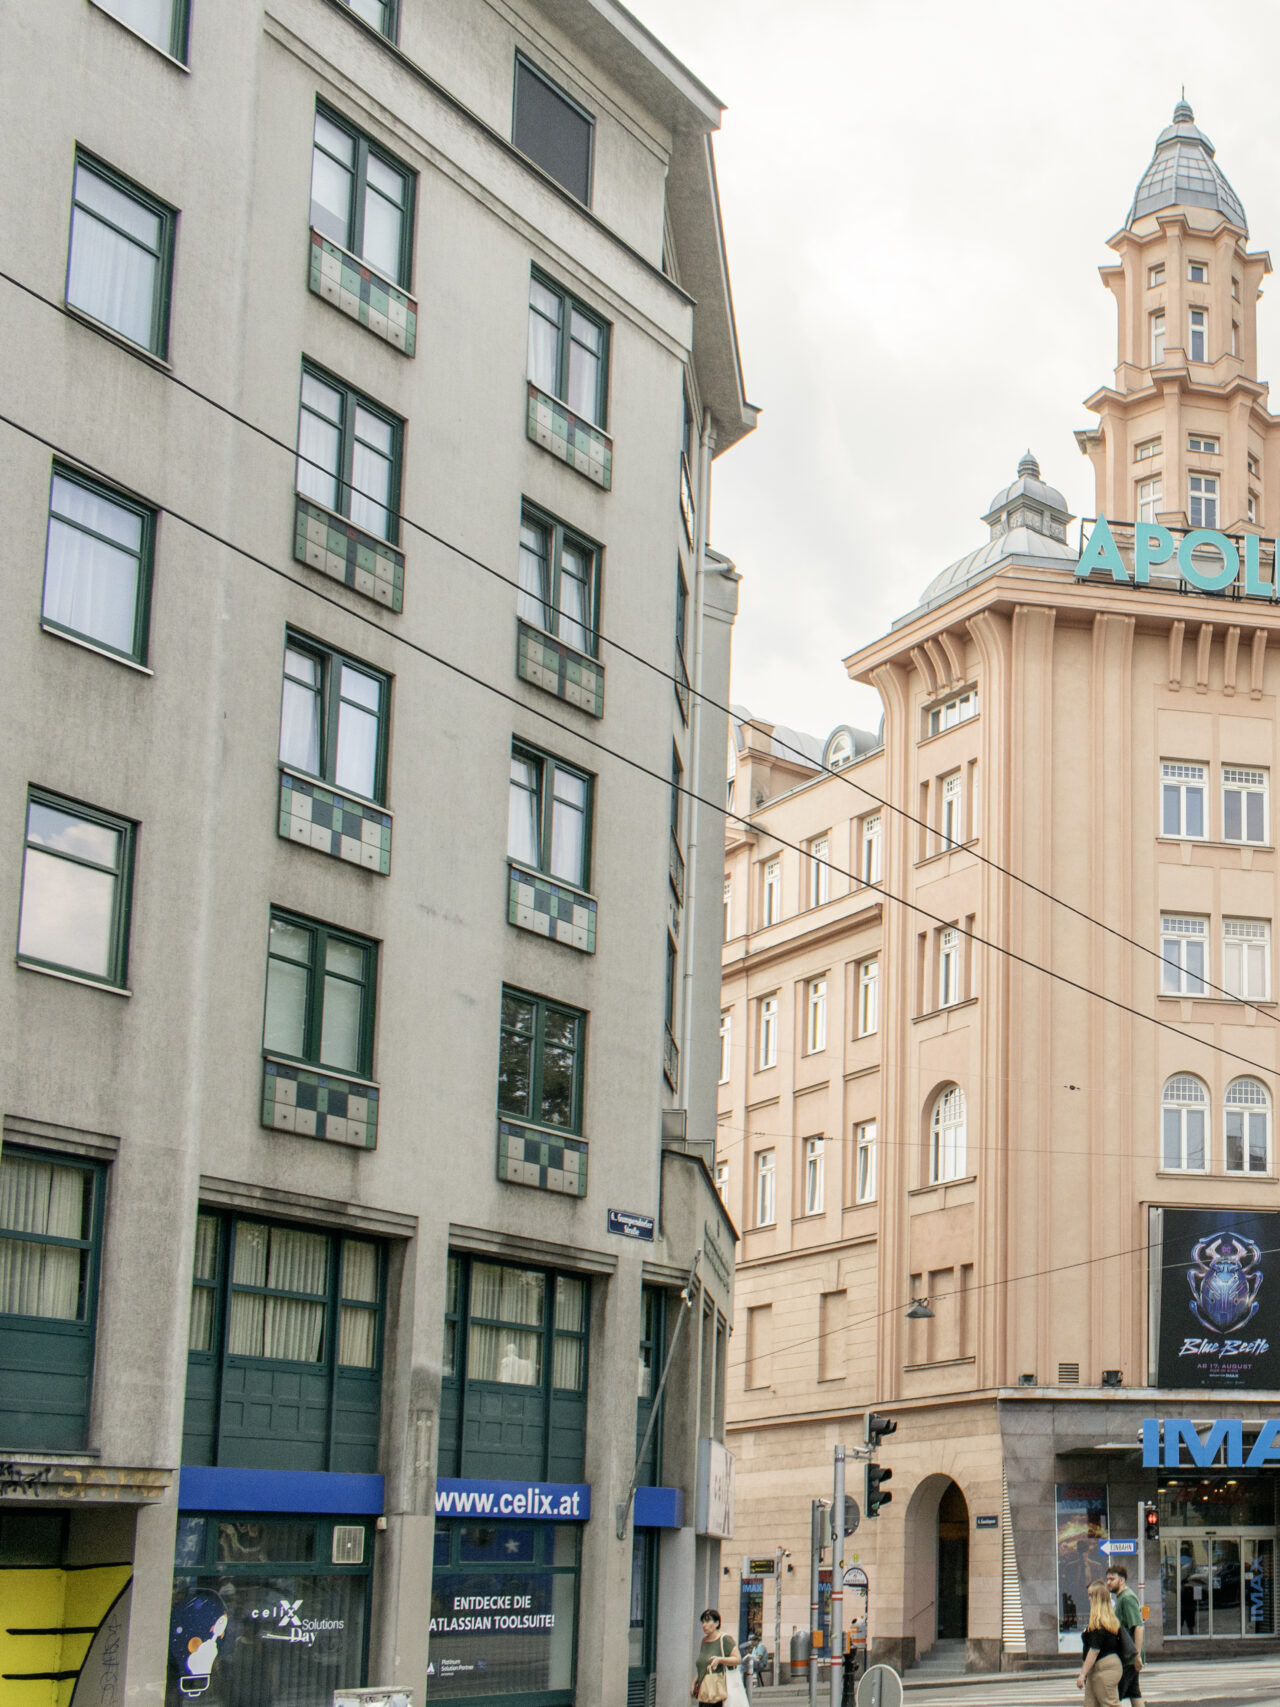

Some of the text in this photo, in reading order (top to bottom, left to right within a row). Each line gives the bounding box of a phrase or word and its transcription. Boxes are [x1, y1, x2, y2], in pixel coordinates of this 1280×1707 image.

[1178, 1338, 1271, 1359] Blue Beetle
[435, 1487, 580, 1516] www.celix.at
[1110, 1543, 1133, 1551] EINBAHN
[742, 1583, 763, 1593] IMAX
[1250, 1555, 1264, 1622] IMAX
[453, 1595, 532, 1610] ENTDECKE DIE
[302, 1618, 345, 1631] Solutions
[428, 1614, 555, 1632] ATLASSIAN TOOLSUITE!
[290, 1628, 317, 1646] Day
